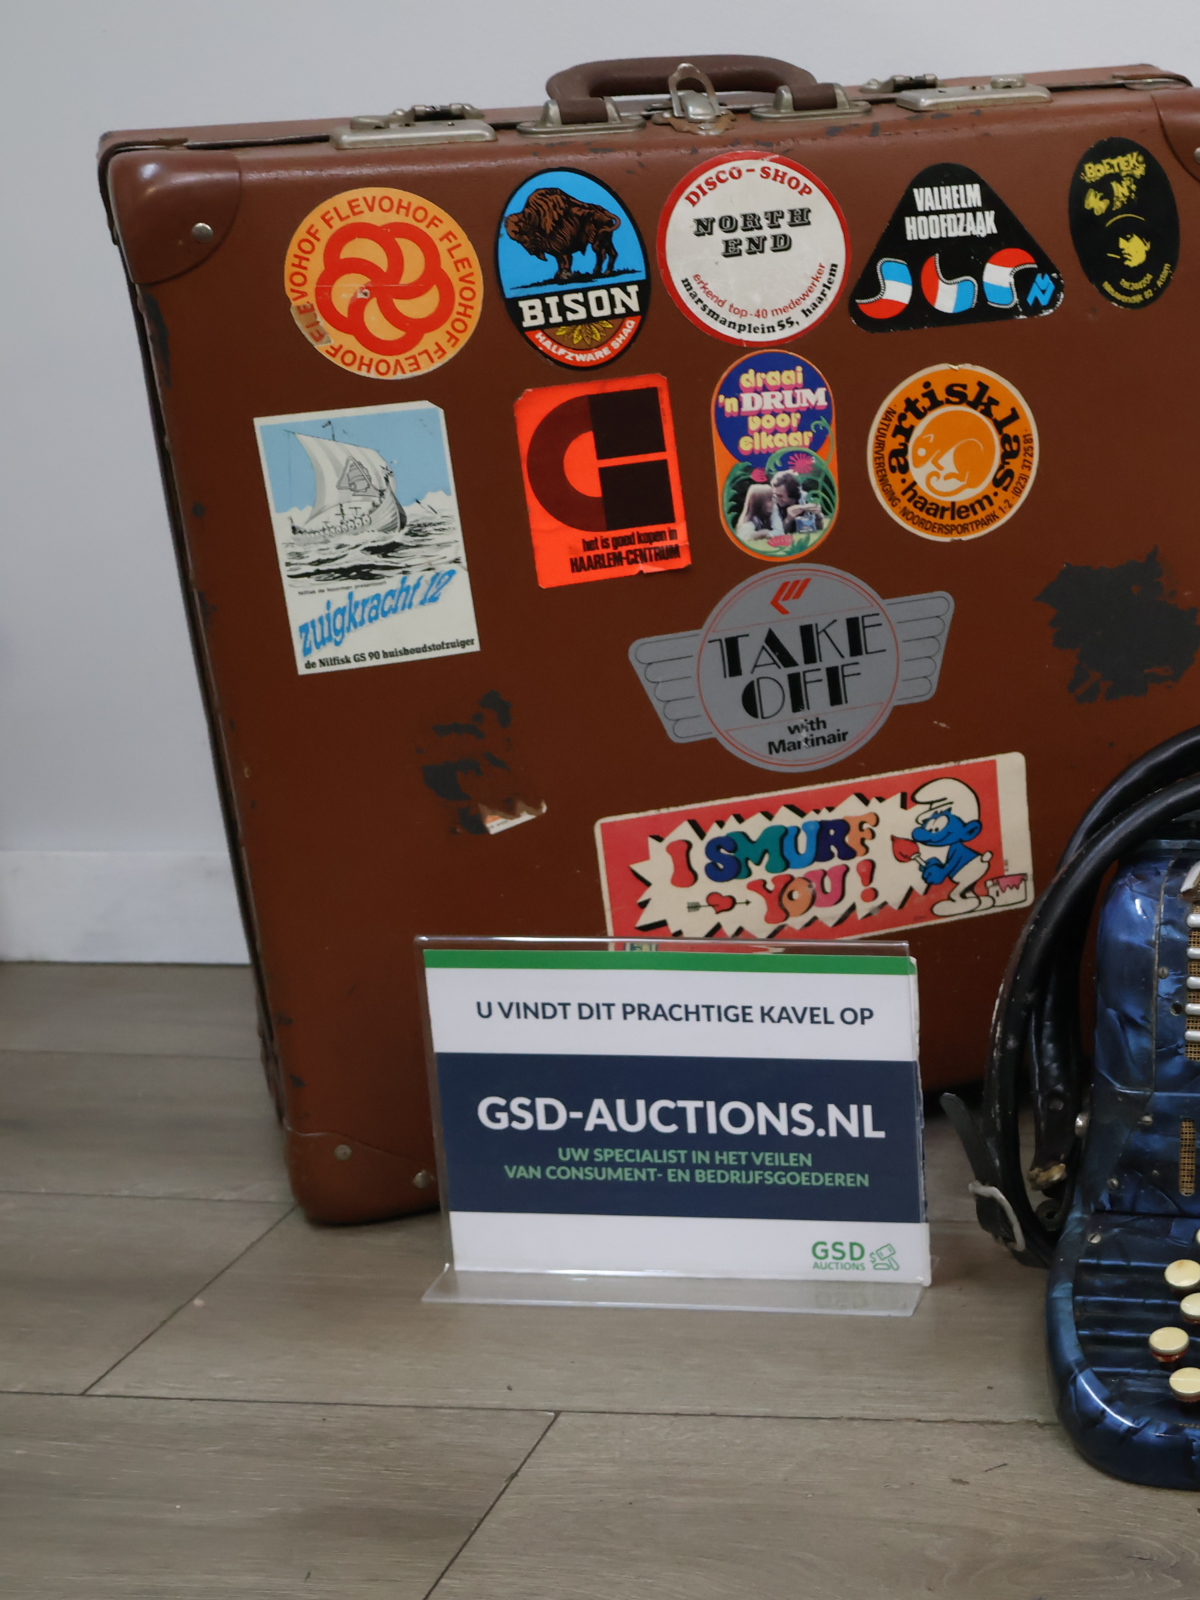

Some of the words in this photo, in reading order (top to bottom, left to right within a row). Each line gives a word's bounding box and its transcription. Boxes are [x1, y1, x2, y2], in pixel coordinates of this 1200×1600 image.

[913, 183, 982, 212] VALHELM
[321, 196, 443, 230] FLEVOHOF
[693, 208, 812, 236] NORTH
[904, 210, 998, 240] HOOFDZAAK
[722, 234, 792, 258] END
[439, 230, 476, 348] FLEVOHOF
[681, 278, 776, 334] marsmanplein
[801, 262, 838, 318] haarlem
[693, 274, 728, 308] erkend
[728, 303, 768, 319] top-40
[771, 262, 826, 316] medewerker
[518, 284, 640, 328] BISON
[534, 331, 612, 362] HALFZWARE
[612, 320, 636, 349] SHAG
[326, 342, 447, 376] FLEVOHOF
[739, 366, 804, 392] draai
[718, 394, 739, 416] 'n
[739, 388, 828, 416] DRUM
[747, 412, 802, 435] voor
[888, 381, 1020, 492] artisklas
[738, 431, 814, 455] elkaar
[874, 406, 901, 507] NATUURVERENIGING
[899, 506, 999, 534] NOORDERSPORTPARK
[1012, 473, 1029, 497] (023)
[901, 481, 994, 520] haarlem
[600, 536, 610, 549] is
[612, 532, 636, 550] goed
[667, 527, 678, 540] in
[570, 544, 681, 573] HAARLEM-CENTRUM
[298, 574, 423, 658] zuigkracht
[420, 568, 457, 606] 12
[304, 659, 317, 670] de
[319, 655, 352, 668] Nilfisk
[353, 653, 367, 663] GS
[368, 651, 381, 661] 90
[707, 613, 887, 679] TAKE
[742, 661, 862, 719] OFF
[787, 717, 827, 734] with
[768, 729, 848, 755] Martinair
[666, 838, 698, 888] I
[705, 811, 879, 883] SMURF
[747, 858, 879, 924] YOU!
[477, 1001, 493, 1020] U
[497, 1001, 572, 1021] VINDT
[578, 1003, 616, 1022] DIT
[622, 1003, 753, 1023] PRACHTIGE
[760, 1006, 835, 1025] KAVEL
[840, 1006, 874, 1026] OP
[477, 1096, 886, 1139] GSD-AUCTIONS.NL
[558, 1148, 590, 1162] UW
[593, 1148, 688, 1164] SPECIALIST
[691, 1150, 708, 1164] IN
[714, 1151, 748, 1165] HET
[751, 1152, 812, 1167] VEILEN
[504, 1166, 541, 1180] VAN
[545, 1166, 663, 1183] CONSUMENT-
[667, 1169, 690, 1183] EN
[695, 1169, 869, 1187] BEDRIJFSGOEDEREN
[812, 1241, 865, 1261] GSD
[812, 1262, 866, 1271] AUCTIONS
